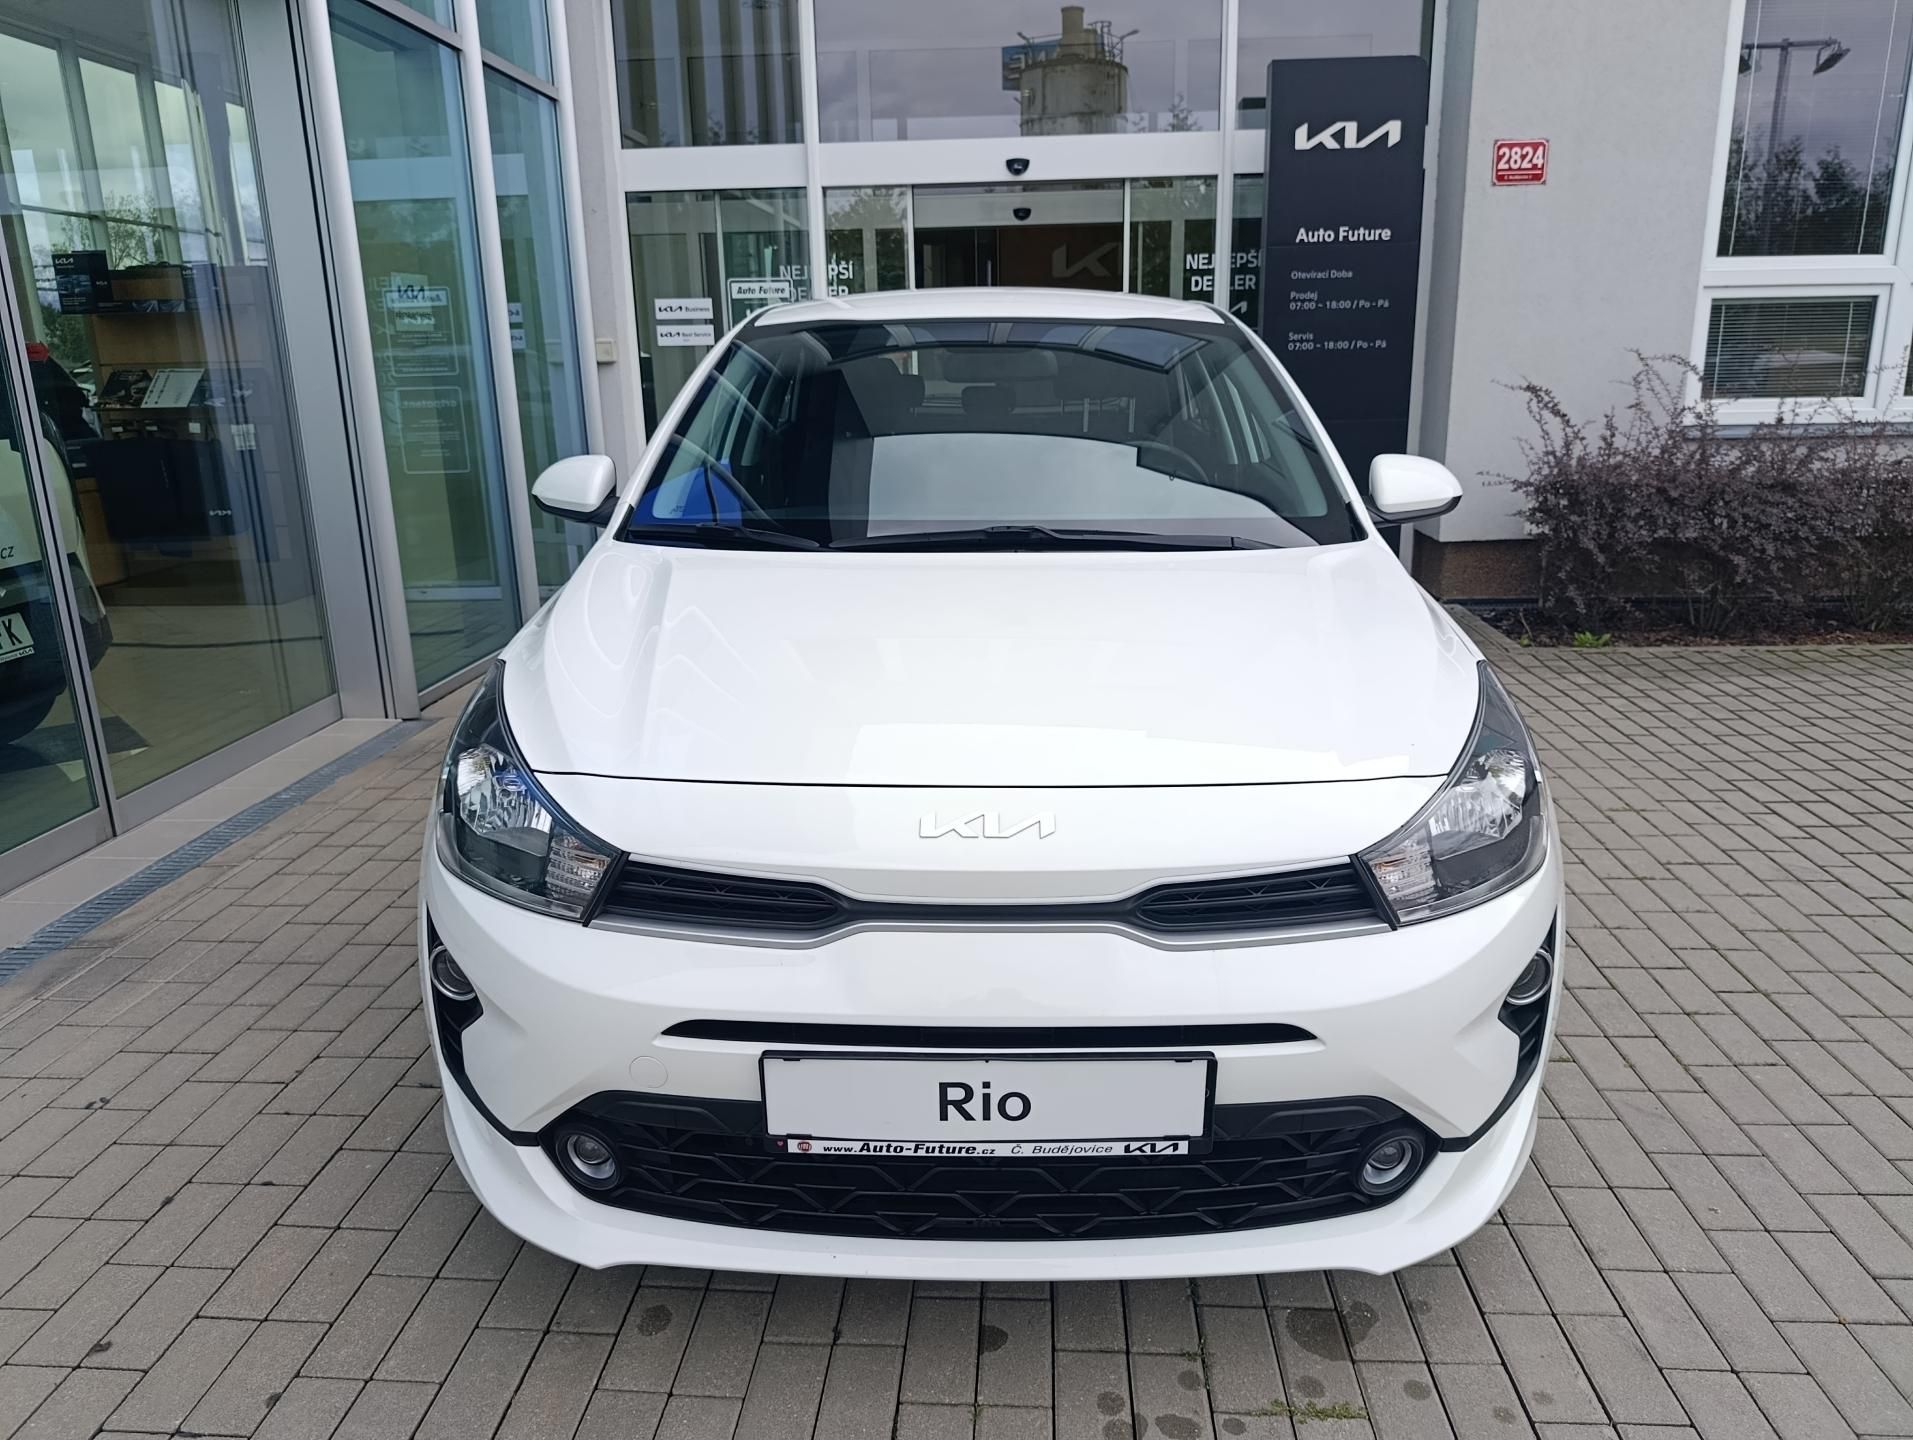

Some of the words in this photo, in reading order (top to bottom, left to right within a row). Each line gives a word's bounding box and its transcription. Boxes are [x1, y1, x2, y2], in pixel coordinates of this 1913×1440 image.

[1295, 119, 1401, 150] KIA
[1497, 145, 1544, 170] 2824
[1296, 227, 1335, 243] Auto
[1338, 226, 1392, 242] Future
[1330, 269, 1353, 279] Doba
[736, 286, 756, 295] Auto
[758, 286, 786, 295] Future
[1290, 291, 1318, 301] Prodej
[658, 305, 683, 313] KIA
[1289, 301, 1316, 310] 07:00
[1326, 300, 1351, 309] 18:00
[1358, 300, 1370, 308] Po
[1288, 332, 1314, 341] Servis
[1287, 342, 1314, 351] 07:00
[1324, 341, 1349, 350] 18:00
[1356, 340, 1368, 349] Po
[919, 810, 1056, 839] KIA
[939, 1081, 1032, 1121] Rio
[823, 1142, 996, 1155] www.Auto-Future.cz
[1010, 1143, 1025, 1155] Č.
[1031, 1144, 1113, 1156] Budějovice
[1124, 1142, 1179, 1154] KIA
